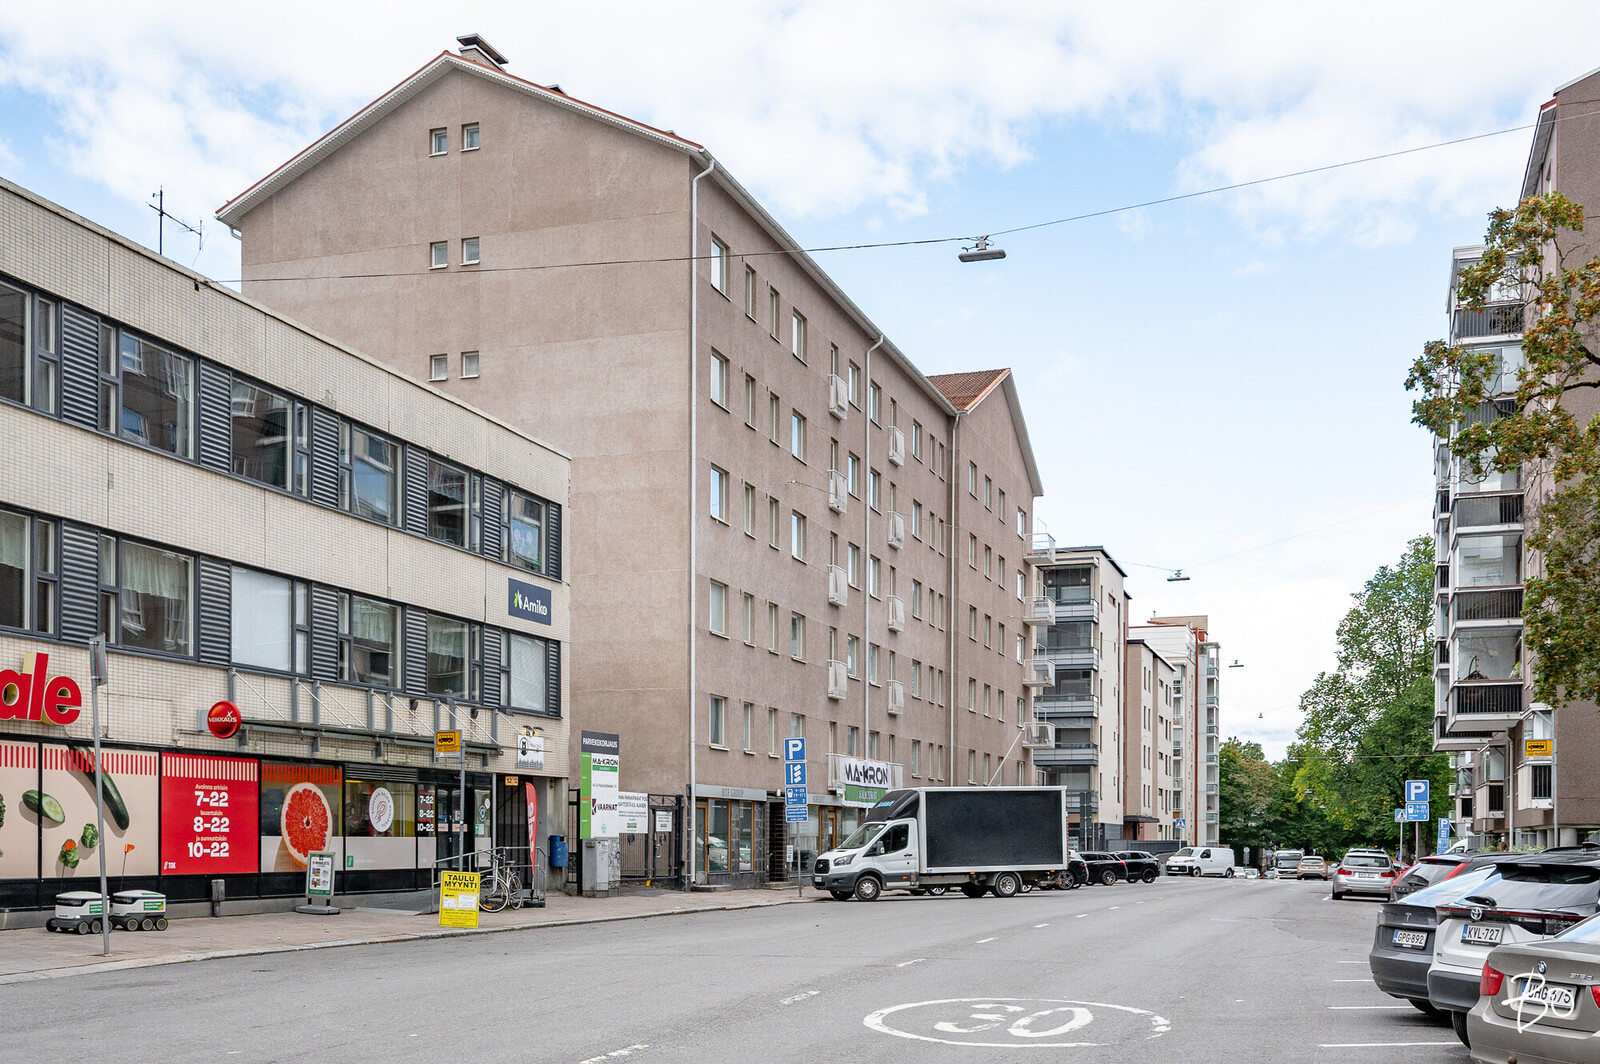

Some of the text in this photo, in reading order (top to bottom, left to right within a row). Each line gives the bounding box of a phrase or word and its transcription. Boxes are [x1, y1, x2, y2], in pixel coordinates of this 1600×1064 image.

[523, 596, 547, 615] Amiko
[788, 740, 803, 760] P
[194, 790, 229, 807] 7-22
[419, 795, 434, 804] 7-22
[1410, 782, 1426, 801] P
[419, 809, 434, 818] 8-22
[193, 816, 230, 833] 8-22
[417, 823, 435, 832] 10-22
[1441, 819, 1448, 828] P
[187, 841, 230, 858] 10-22
[444, 881, 477, 889] MYYNTI
[448, 874, 475, 882] TAULU
[933, 1003, 1094, 1038] 30
